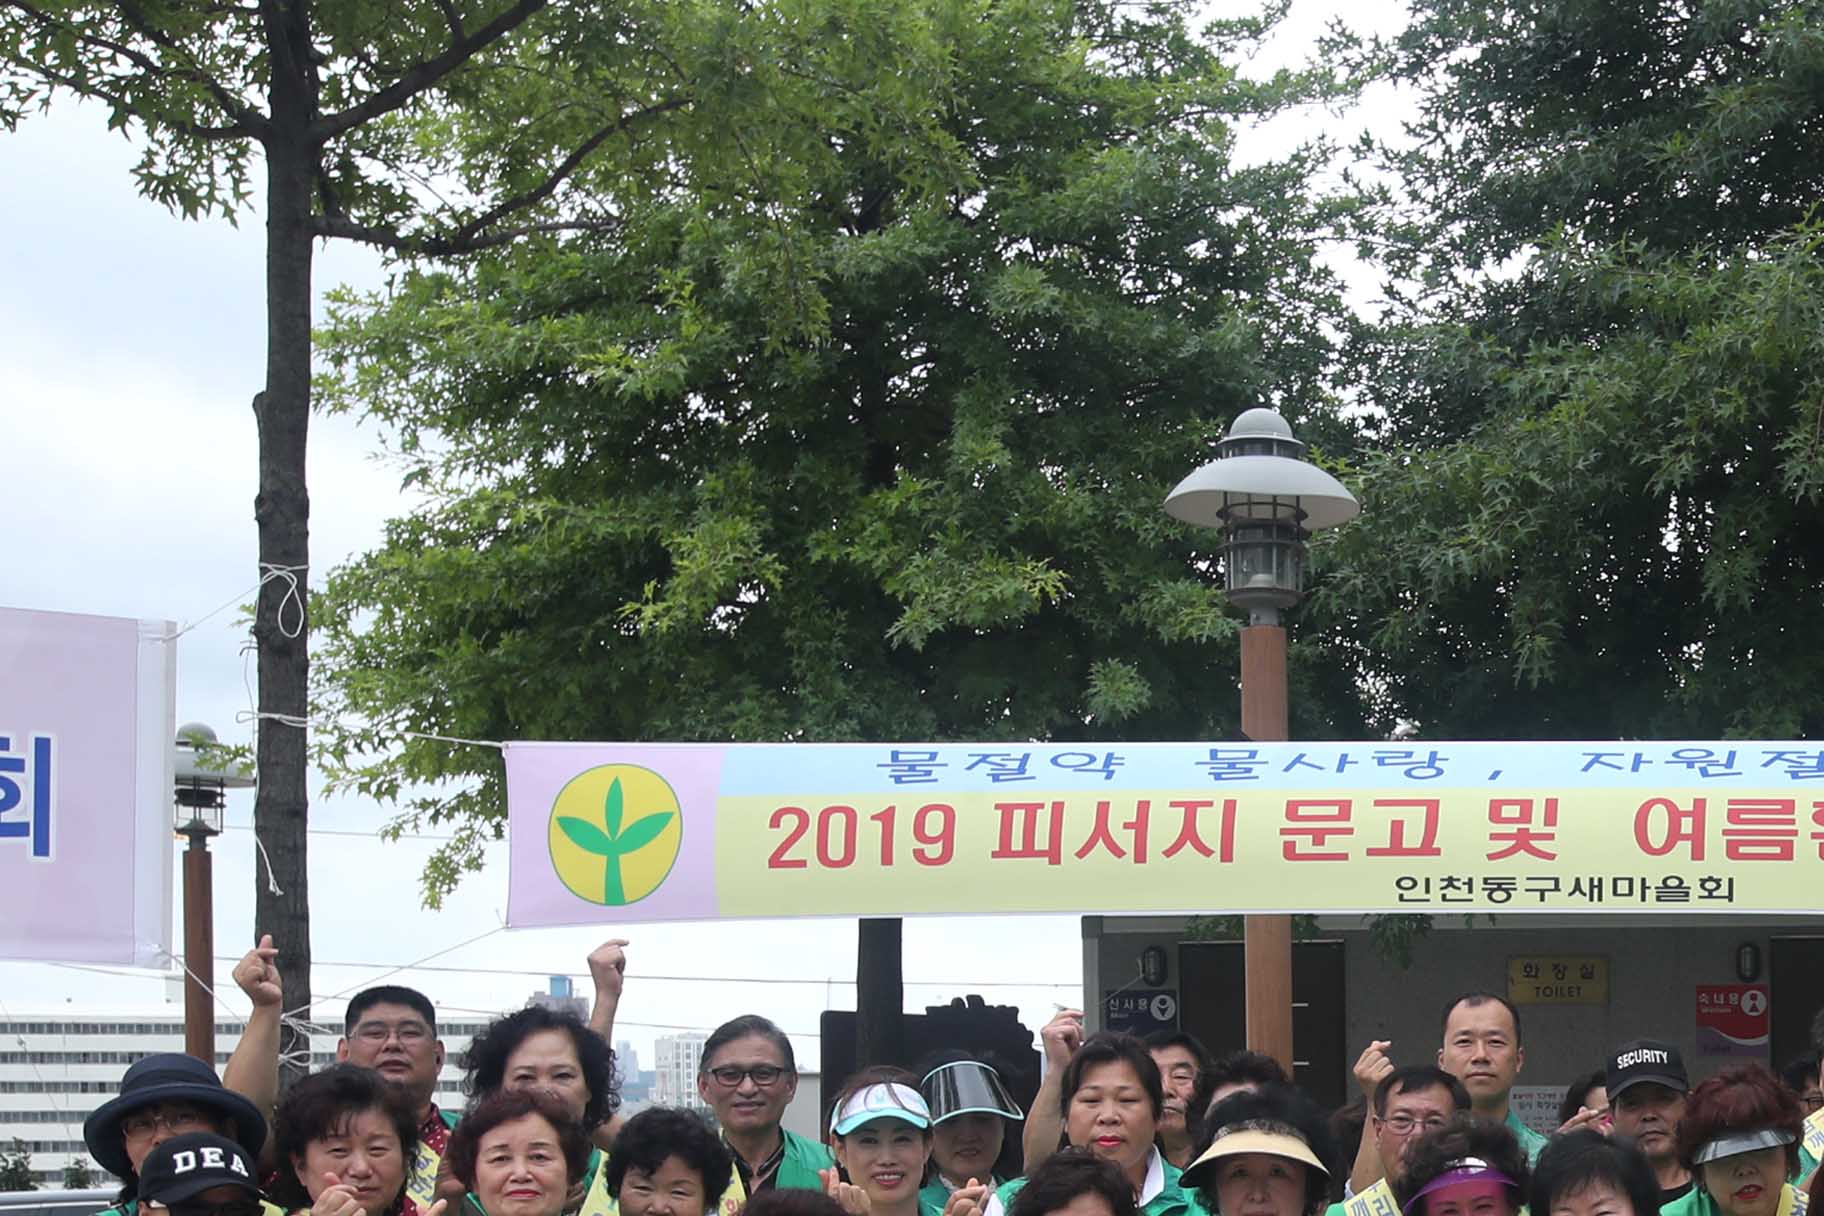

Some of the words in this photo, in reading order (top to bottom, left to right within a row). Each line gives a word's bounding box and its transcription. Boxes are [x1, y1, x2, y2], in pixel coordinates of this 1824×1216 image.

[876, 749, 1124, 785] 물절약
[767, 803, 957, 870] 2019
[991, 800, 1238, 865] 피서지
[1279, 799, 1442, 862] 문고
[1486, 798, 1559, 861] 및
[1394, 875, 1736, 904] 인천동구새마을회
[1521, 961, 1597, 981] 화장실
[1535, 985, 1583, 998] TOILET
[1616, 1048, 1668, 1070] SECURITY
[172, 1146, 249, 1179] DEA
